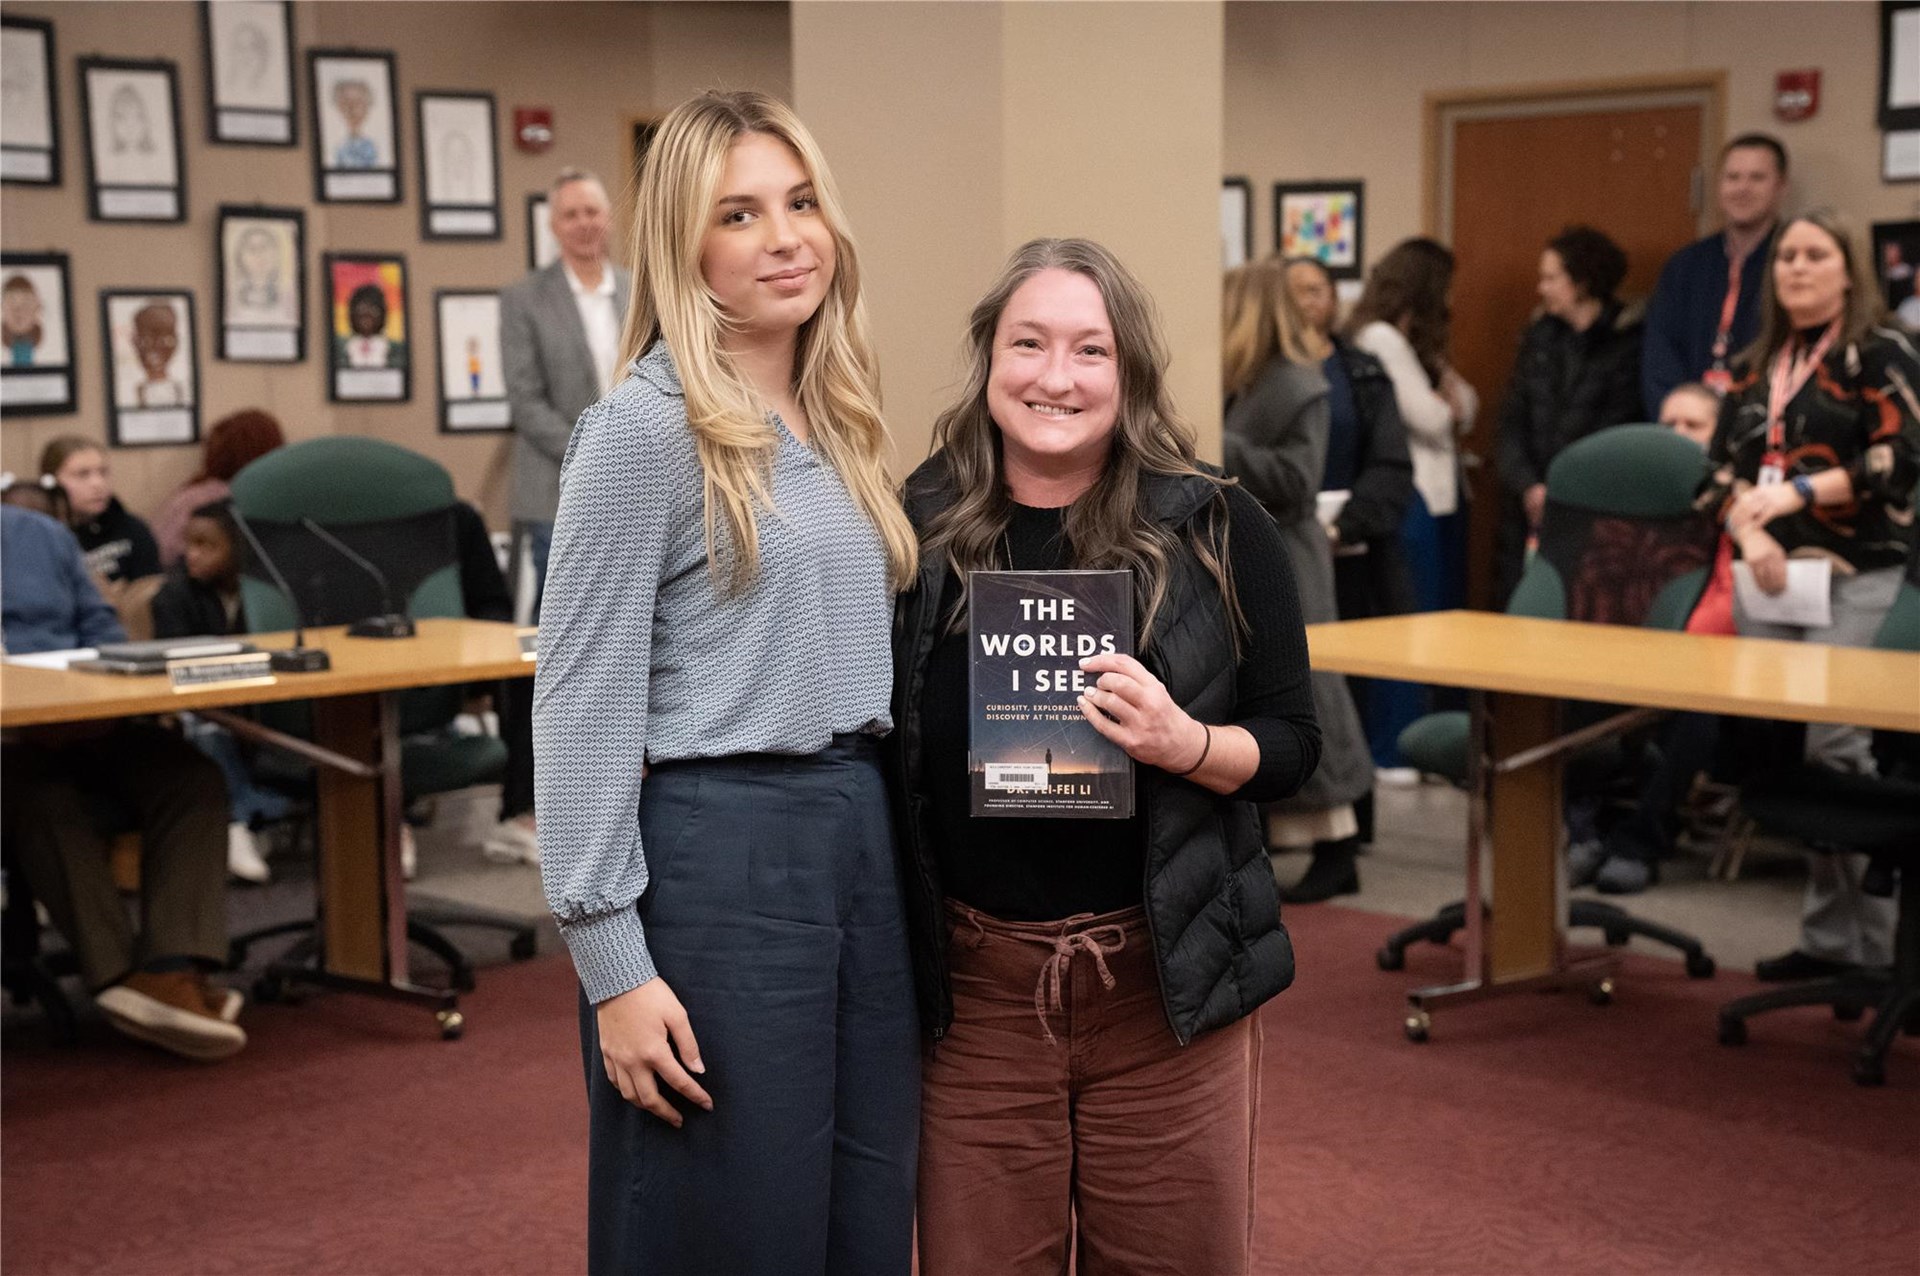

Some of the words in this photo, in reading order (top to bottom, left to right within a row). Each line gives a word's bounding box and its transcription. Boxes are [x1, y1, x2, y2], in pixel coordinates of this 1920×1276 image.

[1020, 599, 1074, 621] THE
[980, 634, 1116, 657] WORLDS
[1012, 670, 1019, 691] I
[1035, 669, 1085, 692] SEE
[1080, 784, 1090, 794] LI
